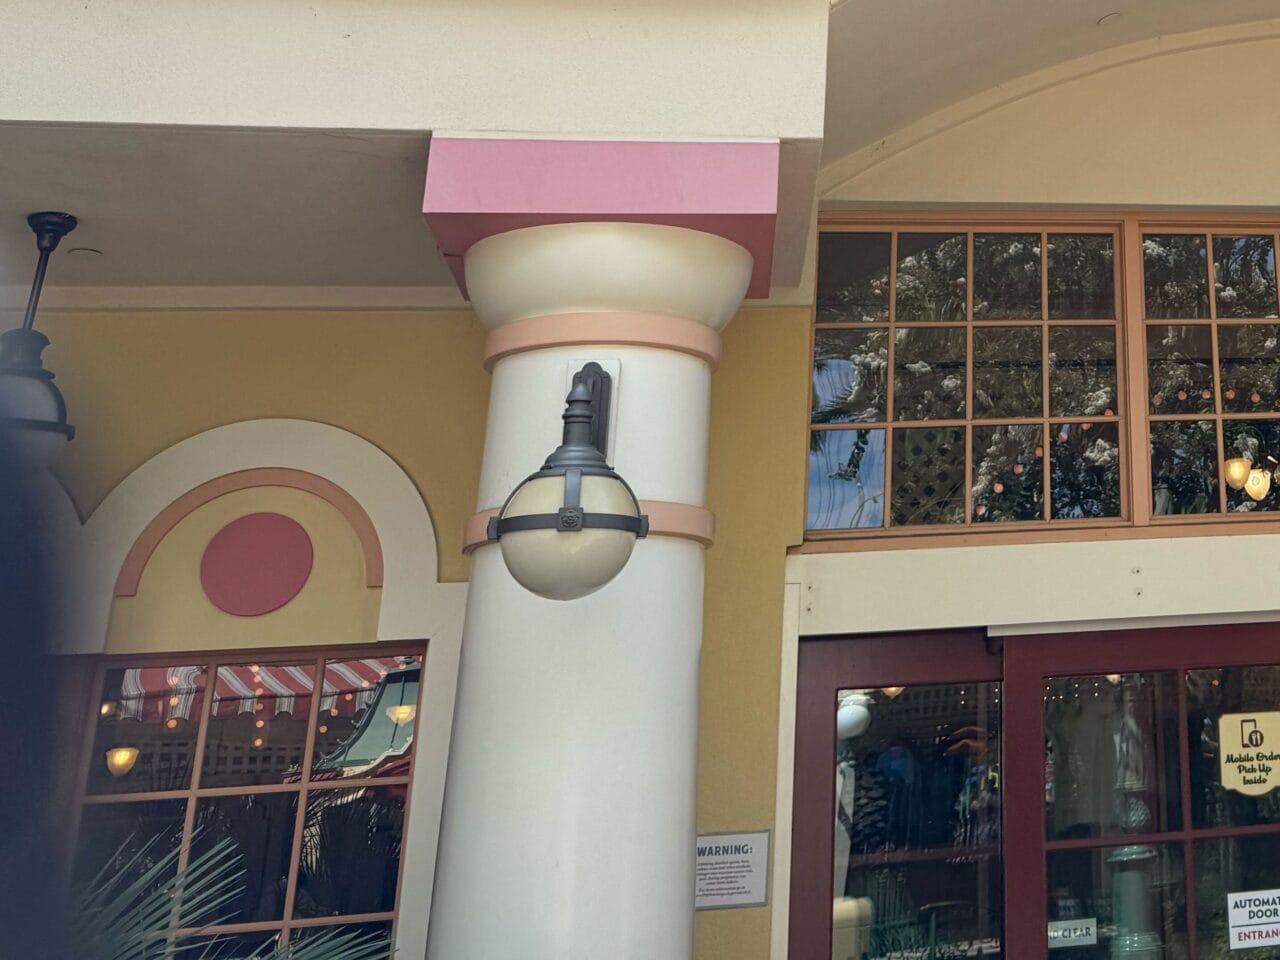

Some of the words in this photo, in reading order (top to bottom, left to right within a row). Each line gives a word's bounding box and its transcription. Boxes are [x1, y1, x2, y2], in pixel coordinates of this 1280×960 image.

[1225, 753, 1254, 763] Mobile
[1237, 765, 1257, 774] Pick
[1258, 763, 1272, 775] Up
[1243, 776, 1267, 785] Inside
[697, 844, 753, 857] WARNING:
[1248, 908, 1280, 919] DOOR
